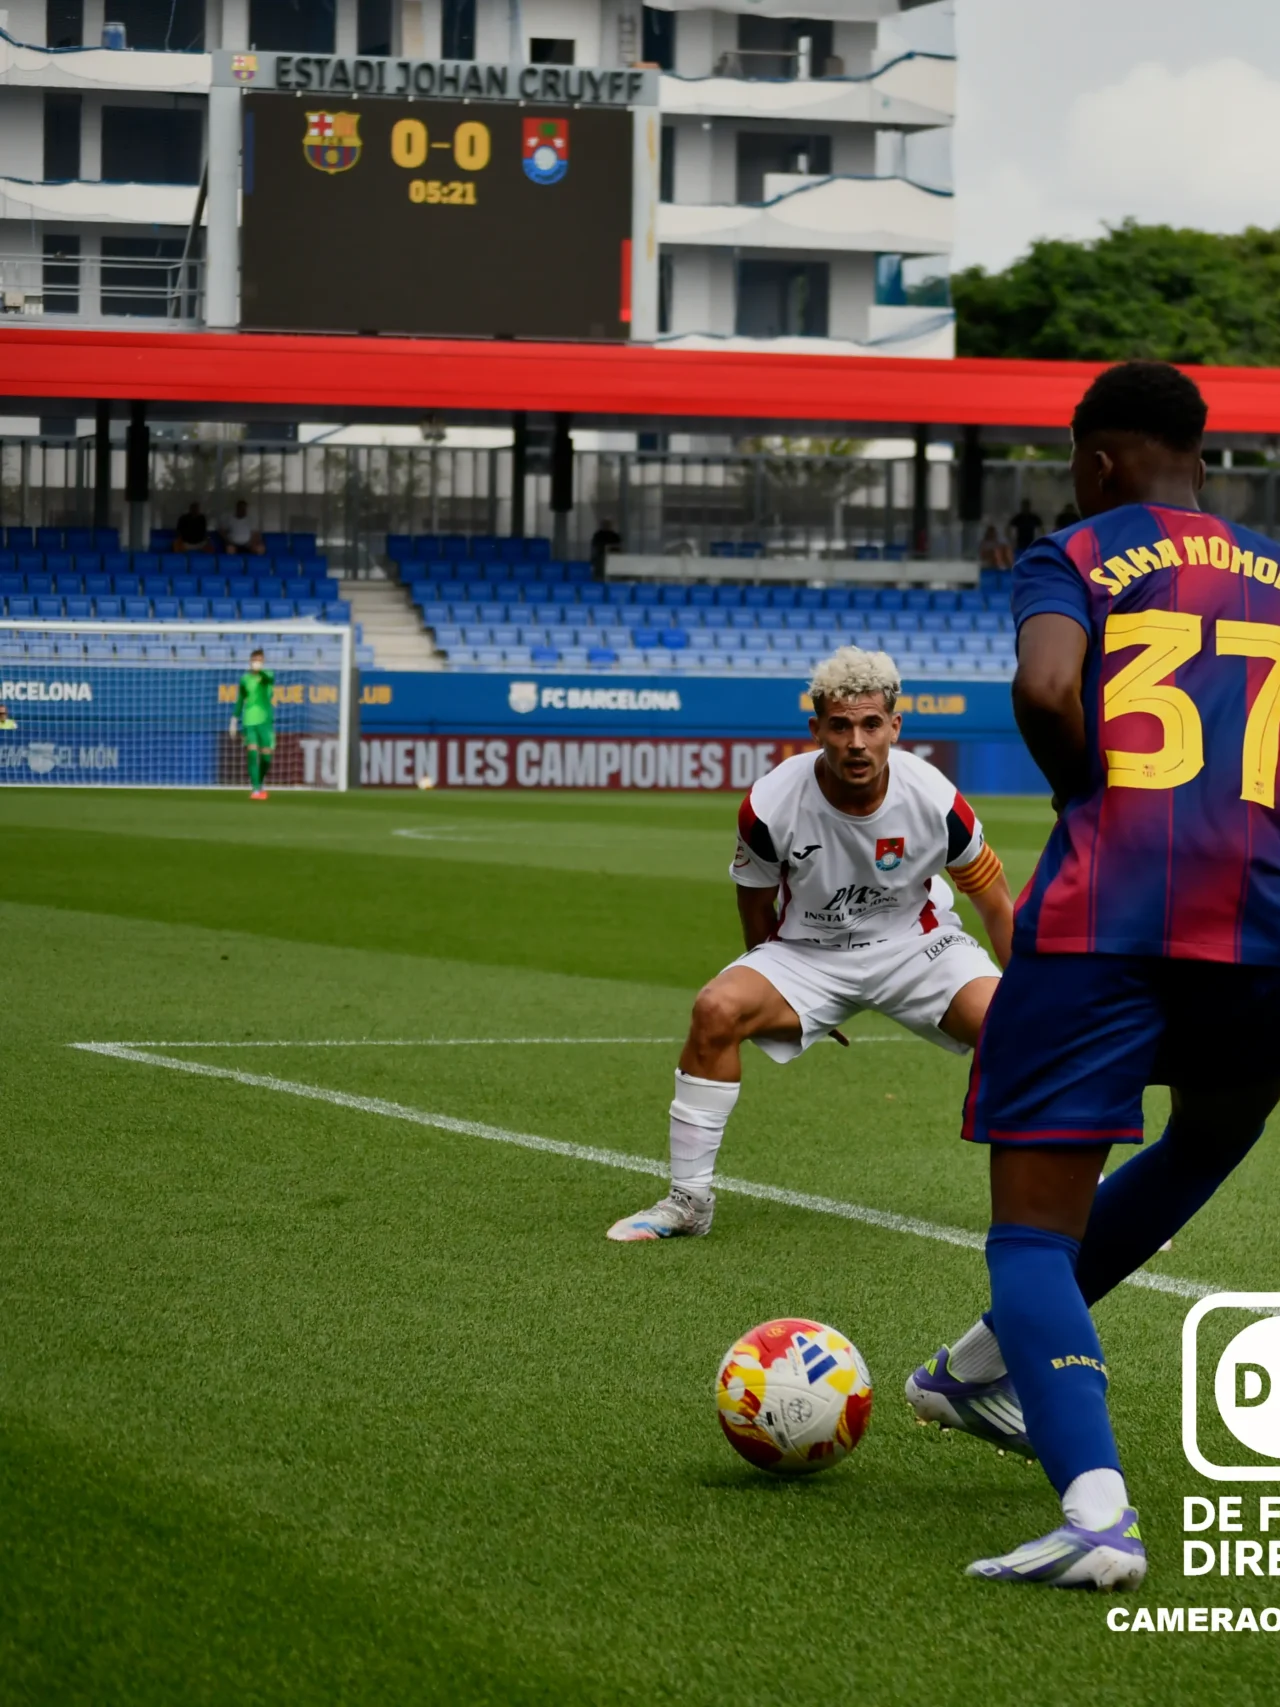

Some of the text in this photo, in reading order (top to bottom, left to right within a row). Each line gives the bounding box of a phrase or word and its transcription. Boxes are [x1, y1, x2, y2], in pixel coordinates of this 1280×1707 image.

[275, 56, 644, 102] ESTADI JOHAN CRUYFF
[408, 179, 477, 205] 05:21
[1090, 538, 1183, 596] SAMA
[0, 681, 92, 701] RCELONA
[541, 687, 680, 710] FC BARCELONA
[447, 740, 508, 787] LES
[516, 740, 724, 790] CAMPIONES
[731, 742, 776, 789] DE
